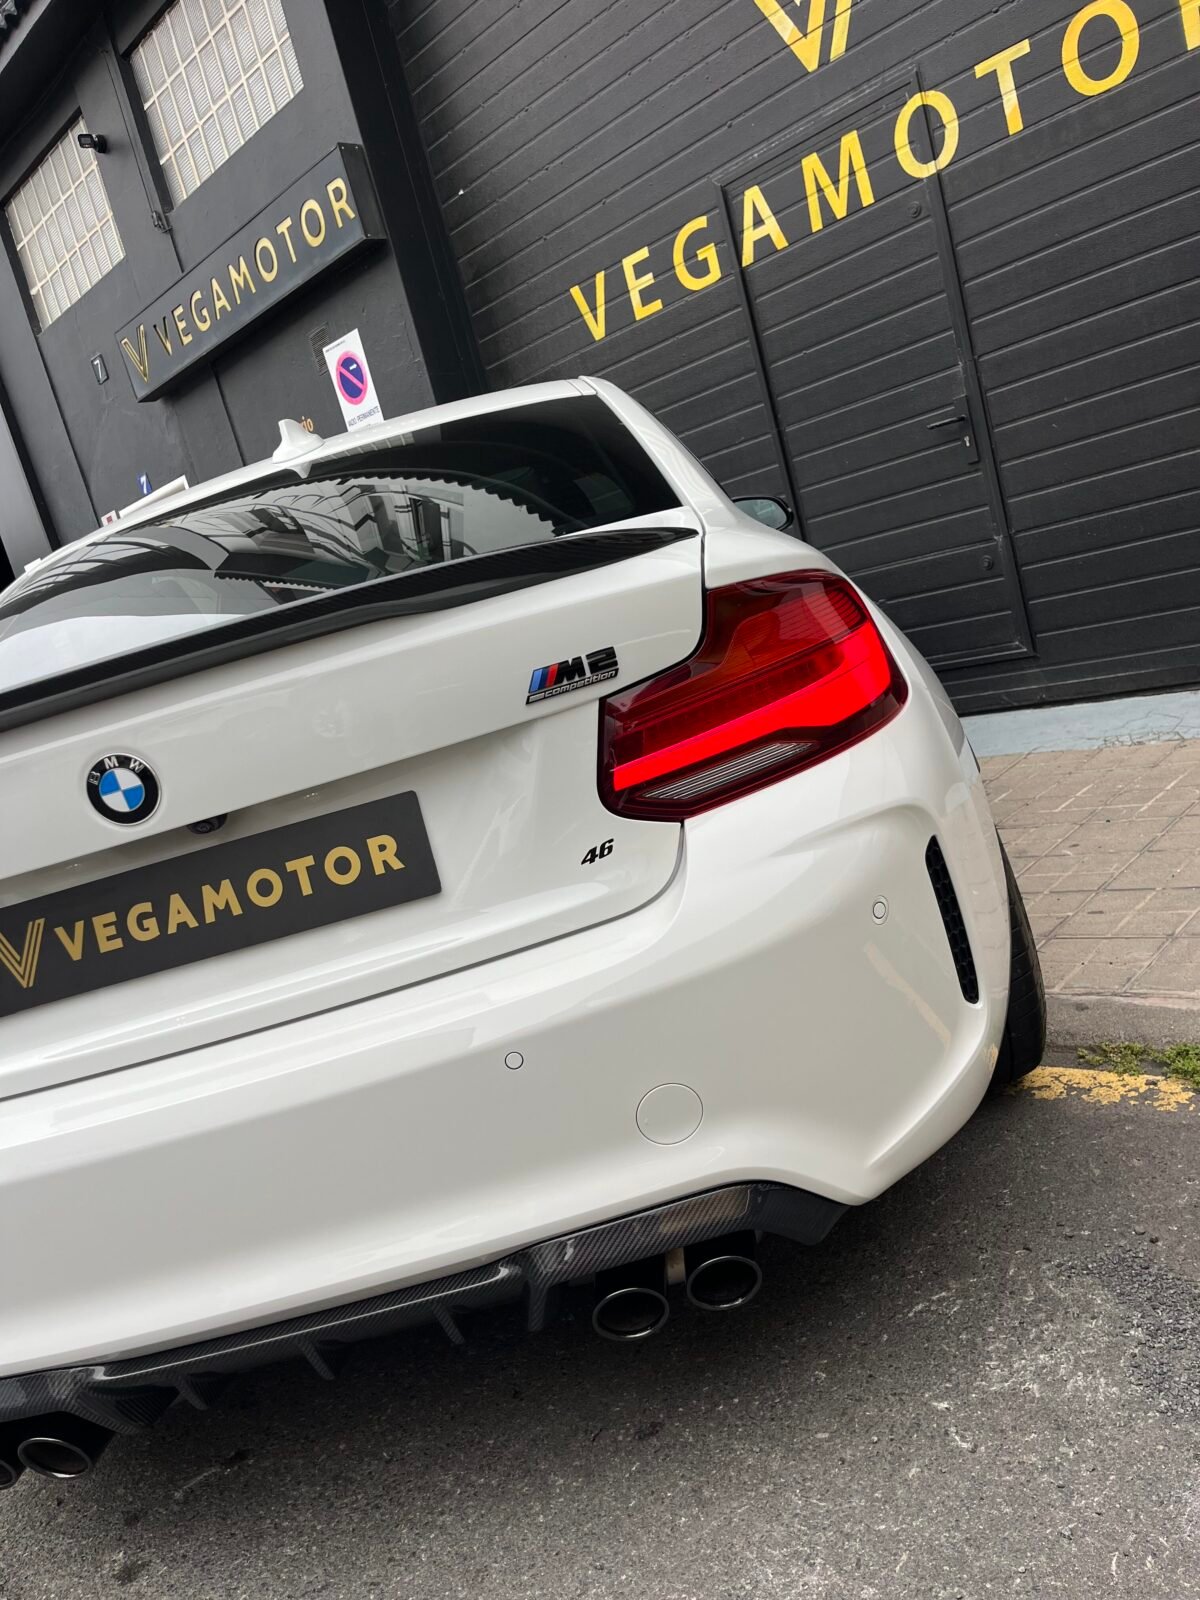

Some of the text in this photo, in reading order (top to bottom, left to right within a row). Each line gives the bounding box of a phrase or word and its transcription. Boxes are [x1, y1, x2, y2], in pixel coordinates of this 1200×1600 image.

[153, 177, 356, 356] VEGAMOTOR
[550, 646, 618, 686] M2
[544, 670, 616, 698] competition
[88, 755, 145, 786] BMW
[581, 838, 614, 865] 46
[54, 834, 406, 961] VEGAMOTOR
